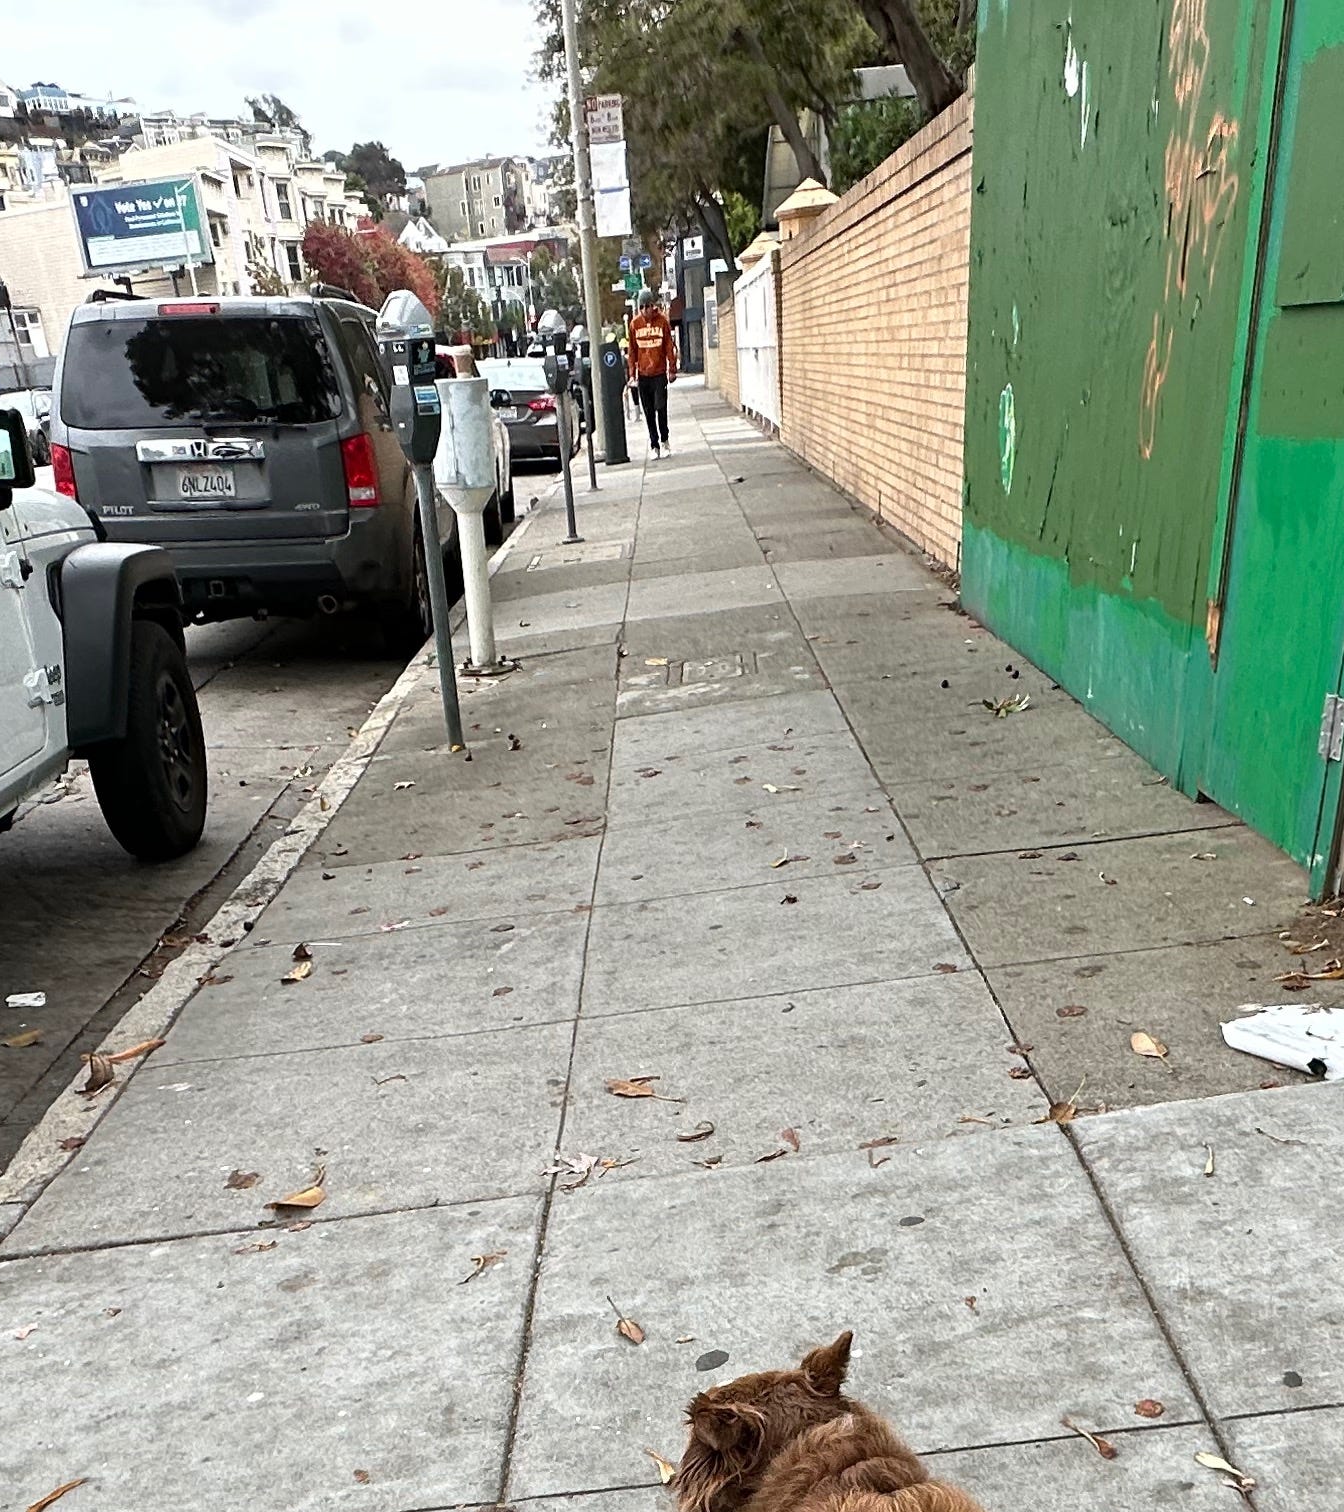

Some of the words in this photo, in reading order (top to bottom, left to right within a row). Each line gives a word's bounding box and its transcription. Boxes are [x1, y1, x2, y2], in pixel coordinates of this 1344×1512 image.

[114, 201, 136, 214] Vote
[136, 199, 153, 211] Yes
[102, 505, 135, 516] PILOT
